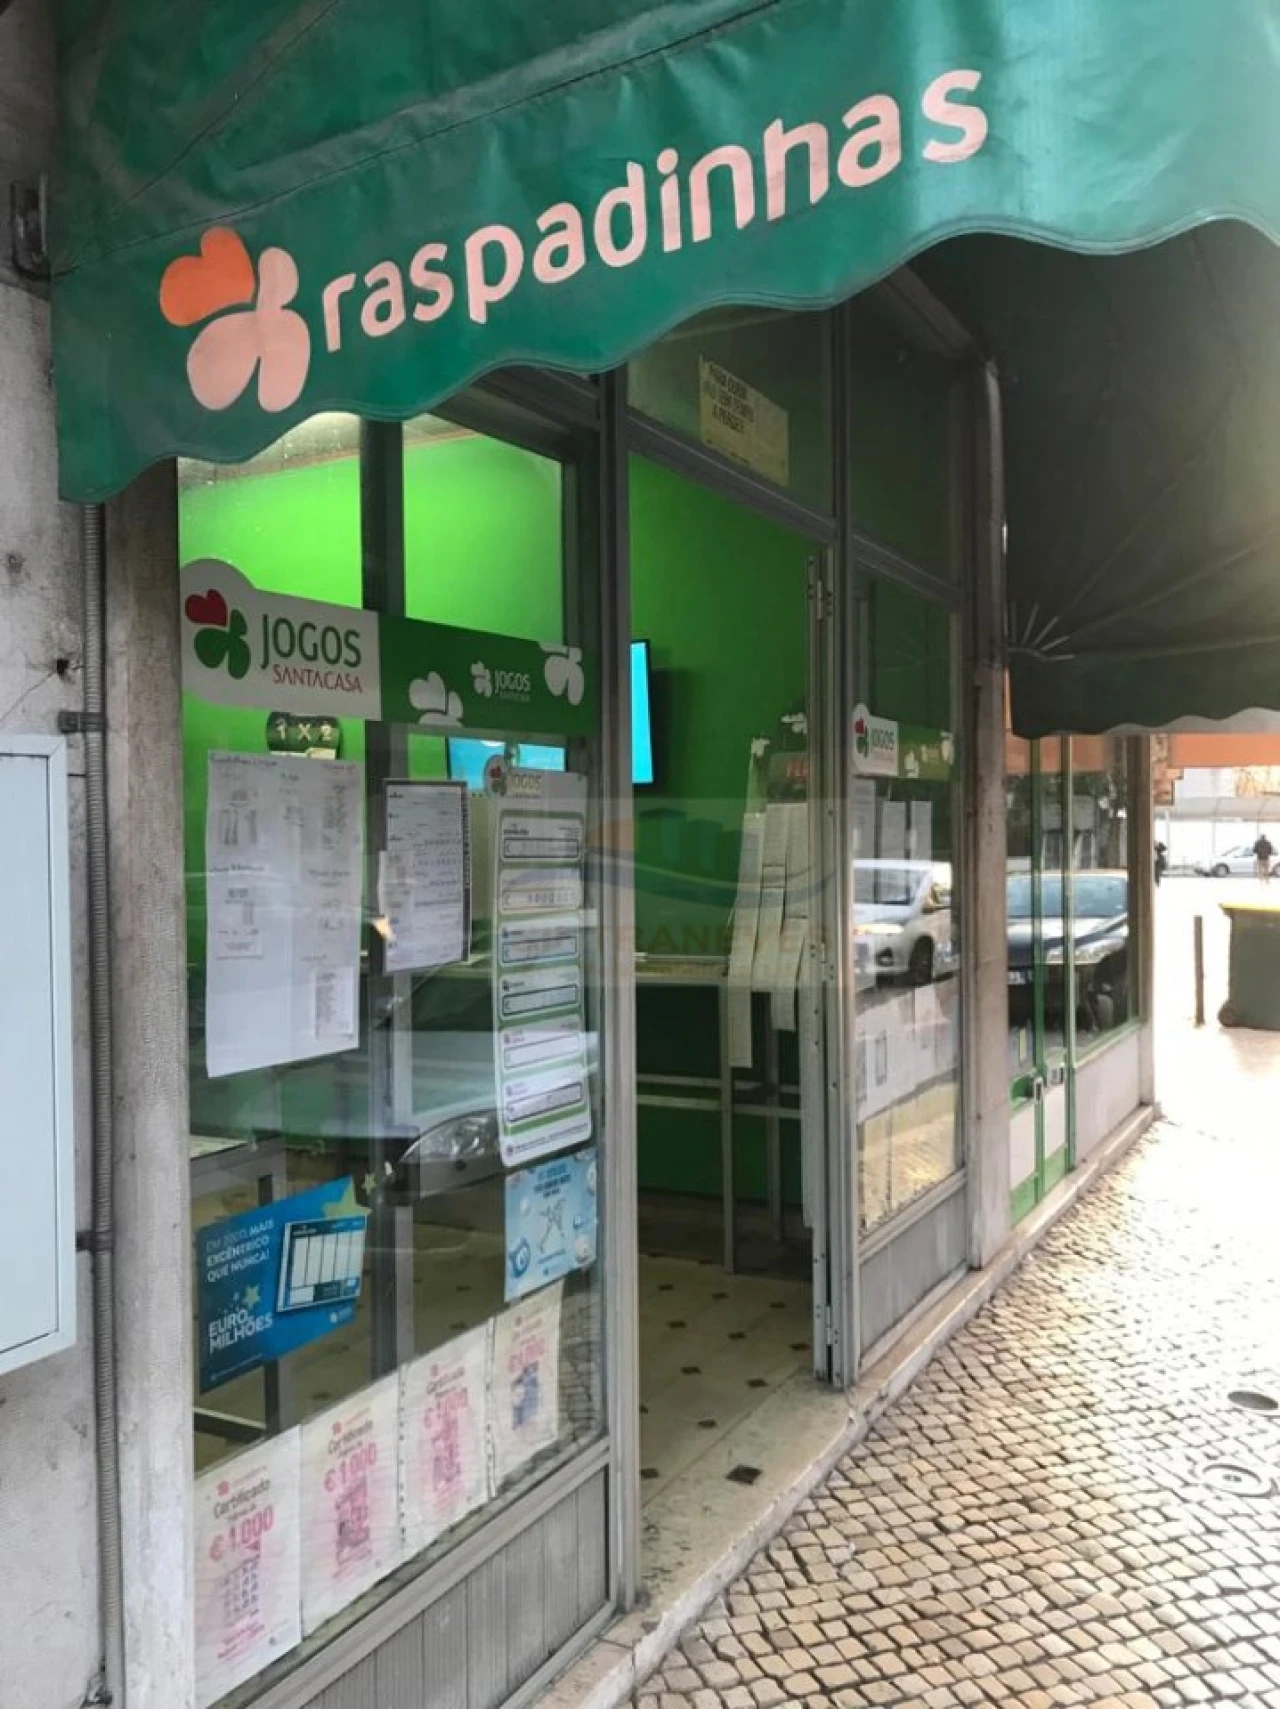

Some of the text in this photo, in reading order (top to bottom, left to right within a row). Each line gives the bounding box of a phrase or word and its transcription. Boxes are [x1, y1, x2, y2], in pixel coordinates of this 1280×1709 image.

[322, 69, 989, 352] raspadinhas
[260, 613, 362, 670] JOGOS
[273, 664, 363, 693] SANTACASA
[494, 669, 531, 695] JOGOS
[208, 1309, 249, 1338] EURO
[209, 1312, 273, 1353] MILHÕES
